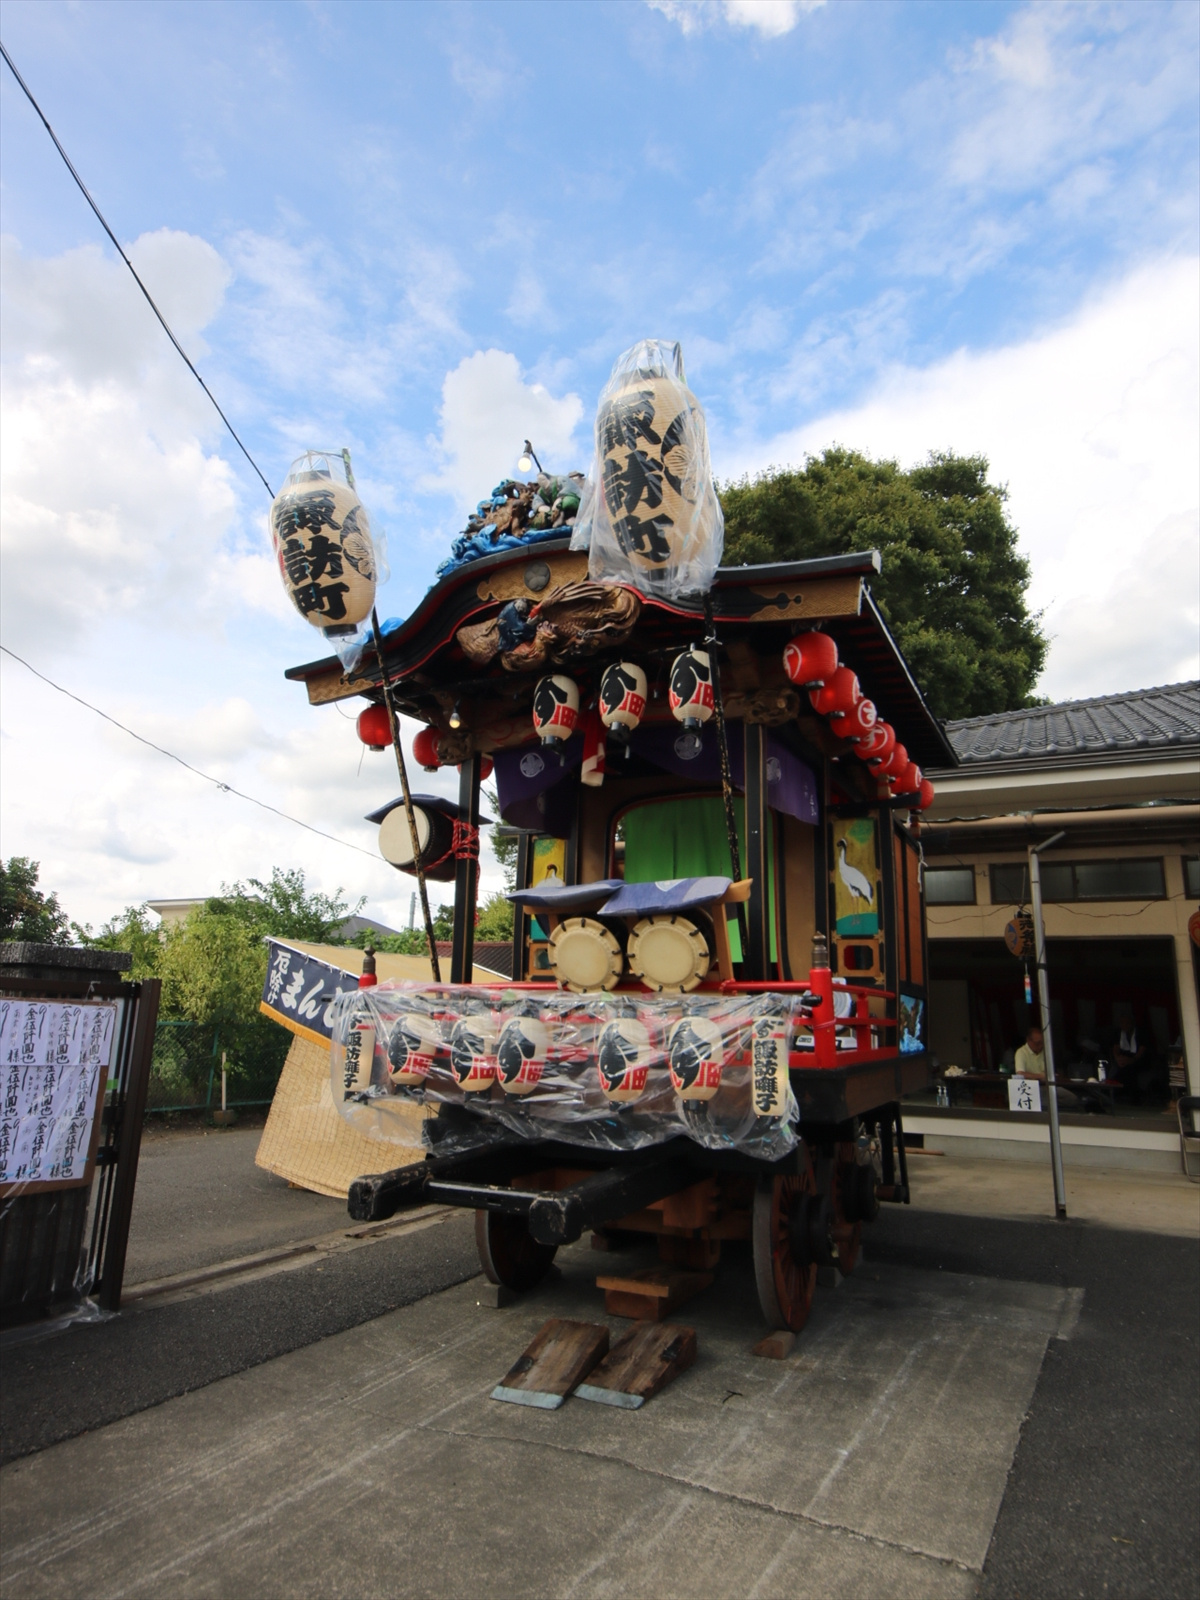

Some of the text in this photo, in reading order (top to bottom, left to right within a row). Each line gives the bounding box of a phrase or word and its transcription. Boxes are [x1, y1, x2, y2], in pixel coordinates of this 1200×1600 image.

[267, 949, 294, 1004] 厄除け
[753, 1039, 779, 1113] 諏訪囃子
[1017, 1080, 1034, 1110] 受付
